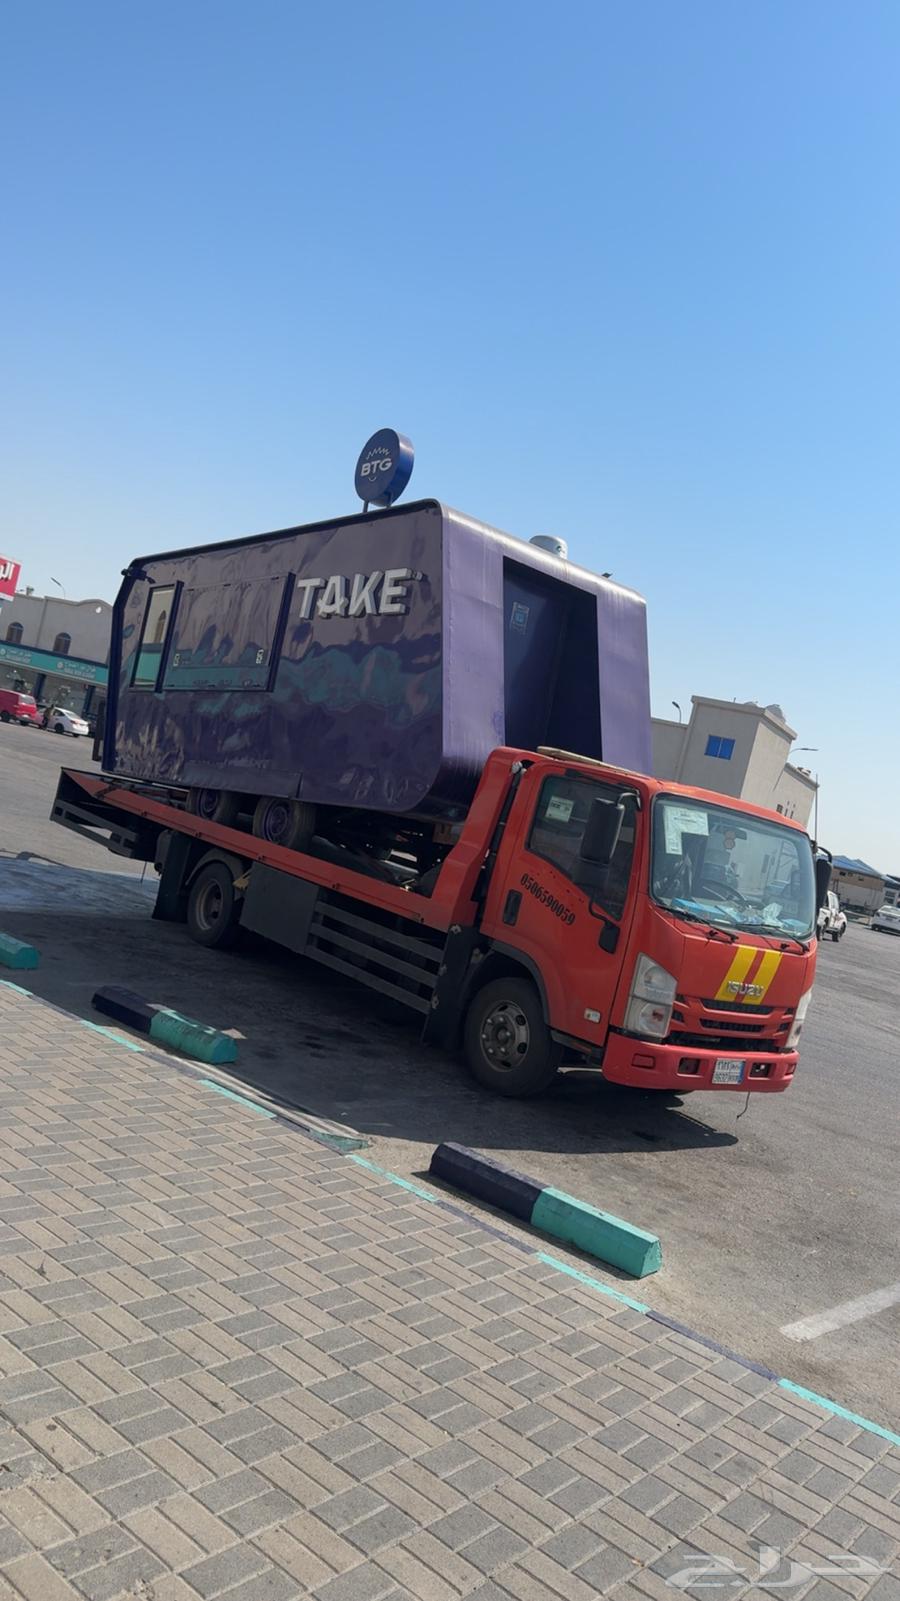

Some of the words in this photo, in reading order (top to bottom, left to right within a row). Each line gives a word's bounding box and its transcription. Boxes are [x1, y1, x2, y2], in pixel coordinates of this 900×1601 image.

[360, 457, 393, 477] BTG
[298, 567, 413, 620] TAKE
[520, 873, 576, 926] 0506590059
[727, 980, 764, 997] ISUZU
